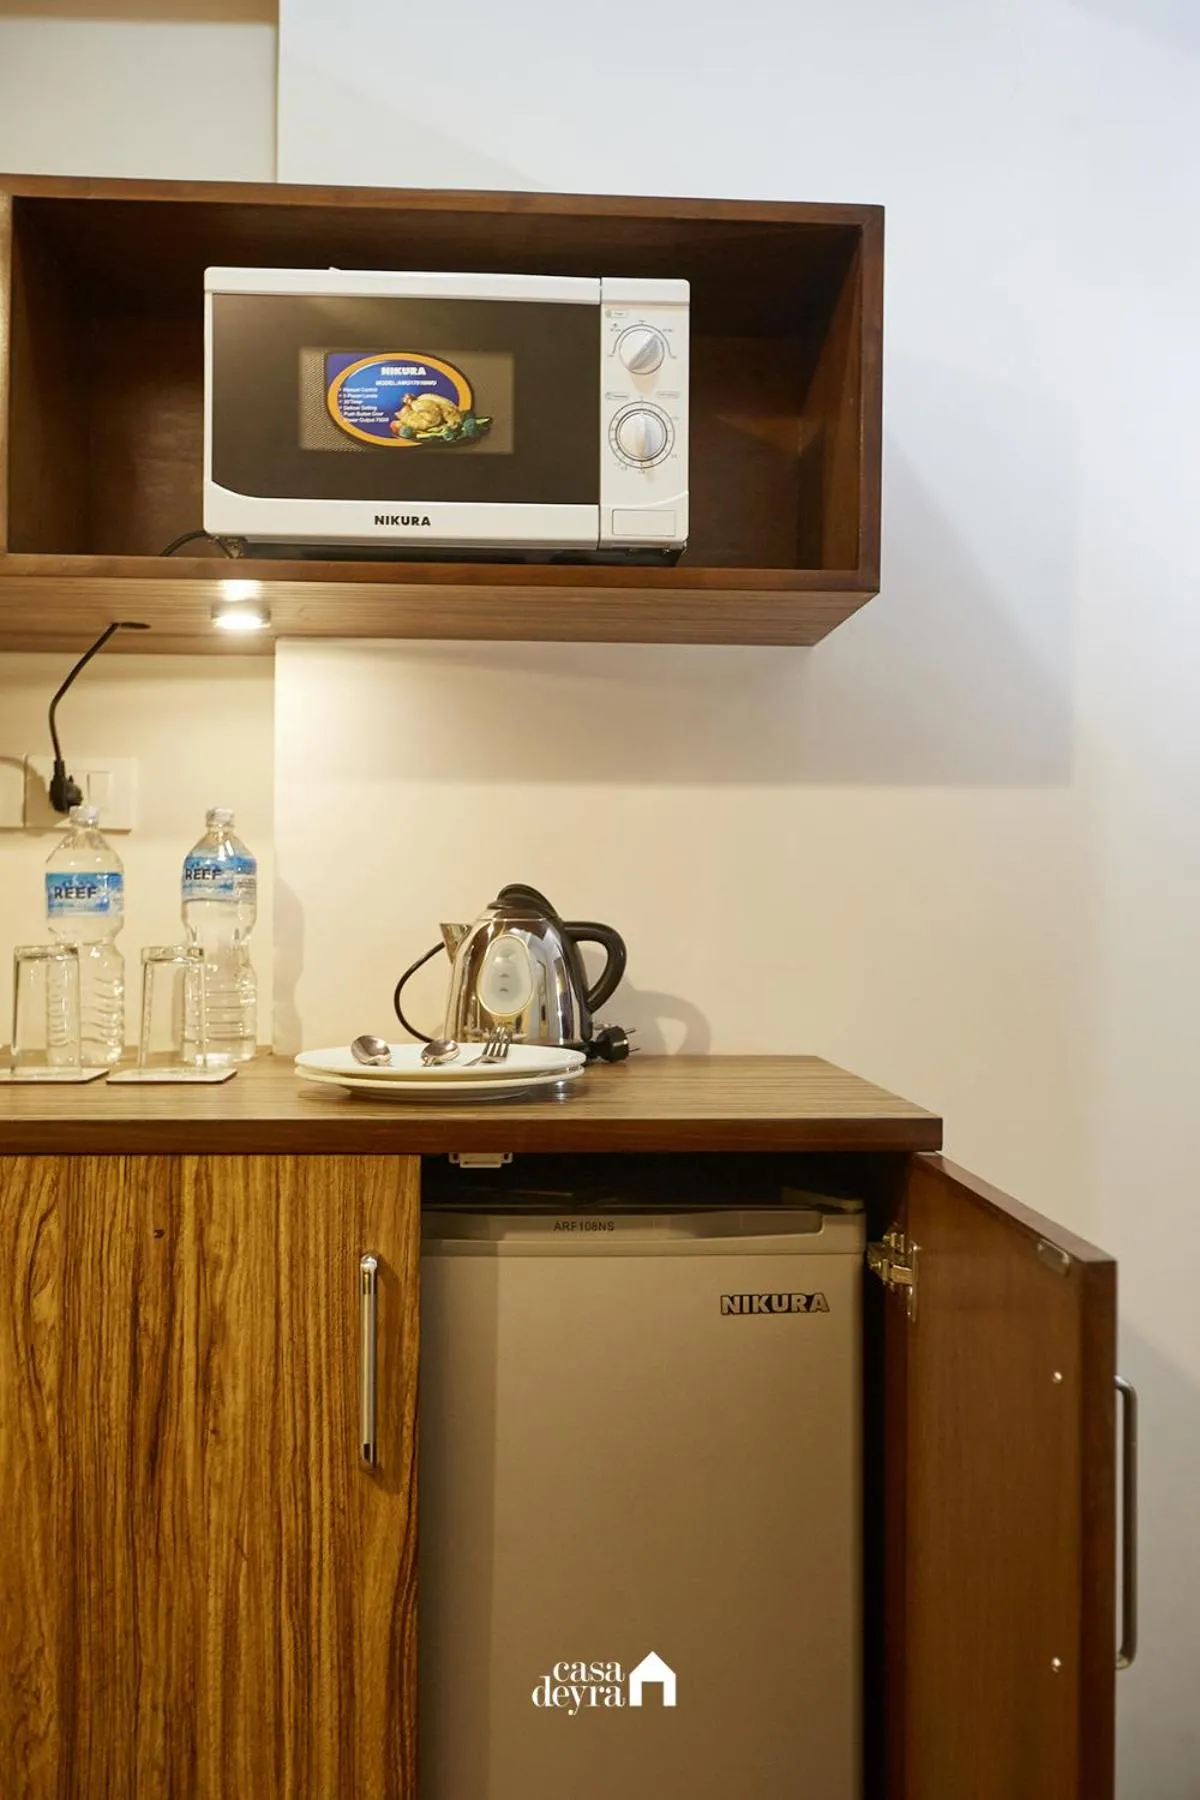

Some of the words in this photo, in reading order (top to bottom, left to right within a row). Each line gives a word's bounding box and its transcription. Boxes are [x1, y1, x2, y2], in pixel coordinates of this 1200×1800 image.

[381, 367, 427, 376] NIKURA
[374, 515, 431, 526] NIKURA
[185, 867, 223, 881] REEF
[54, 886, 98, 900] REEF
[720, 1293, 830, 1316] NIKURA
